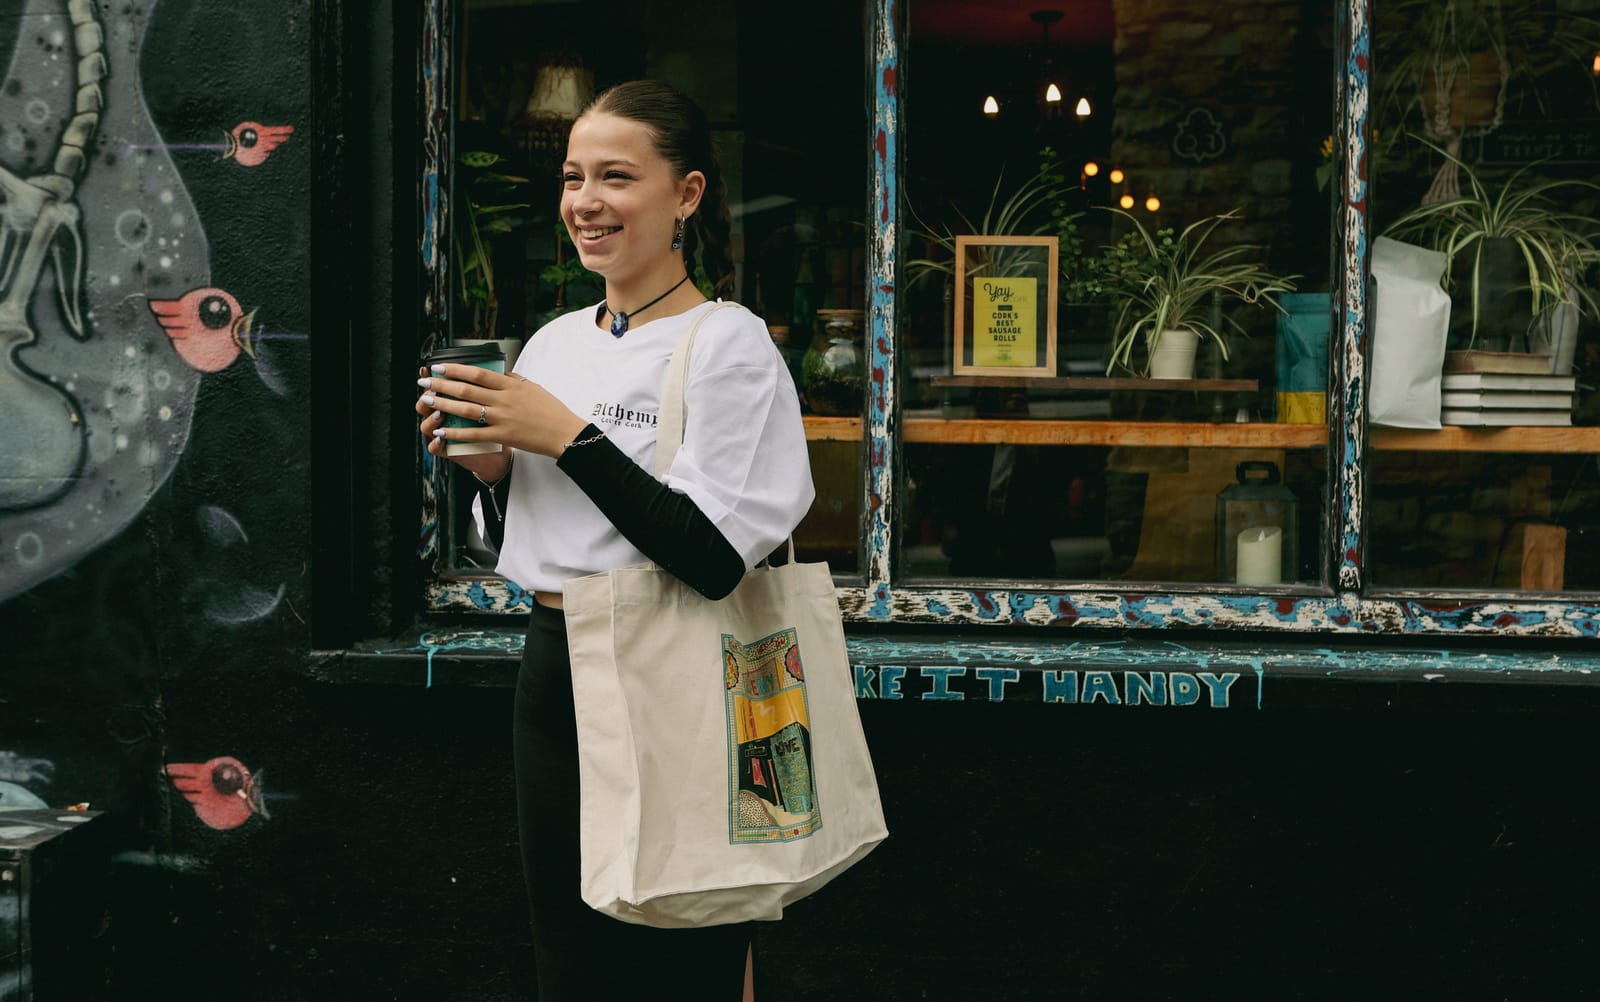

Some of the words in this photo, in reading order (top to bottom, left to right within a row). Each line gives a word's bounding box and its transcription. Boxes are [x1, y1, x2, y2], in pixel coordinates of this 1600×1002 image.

[983, 282, 1014, 302] Yay
[920, 666, 1020, 702] IT
[1041, 669, 1241, 708] HANDY
